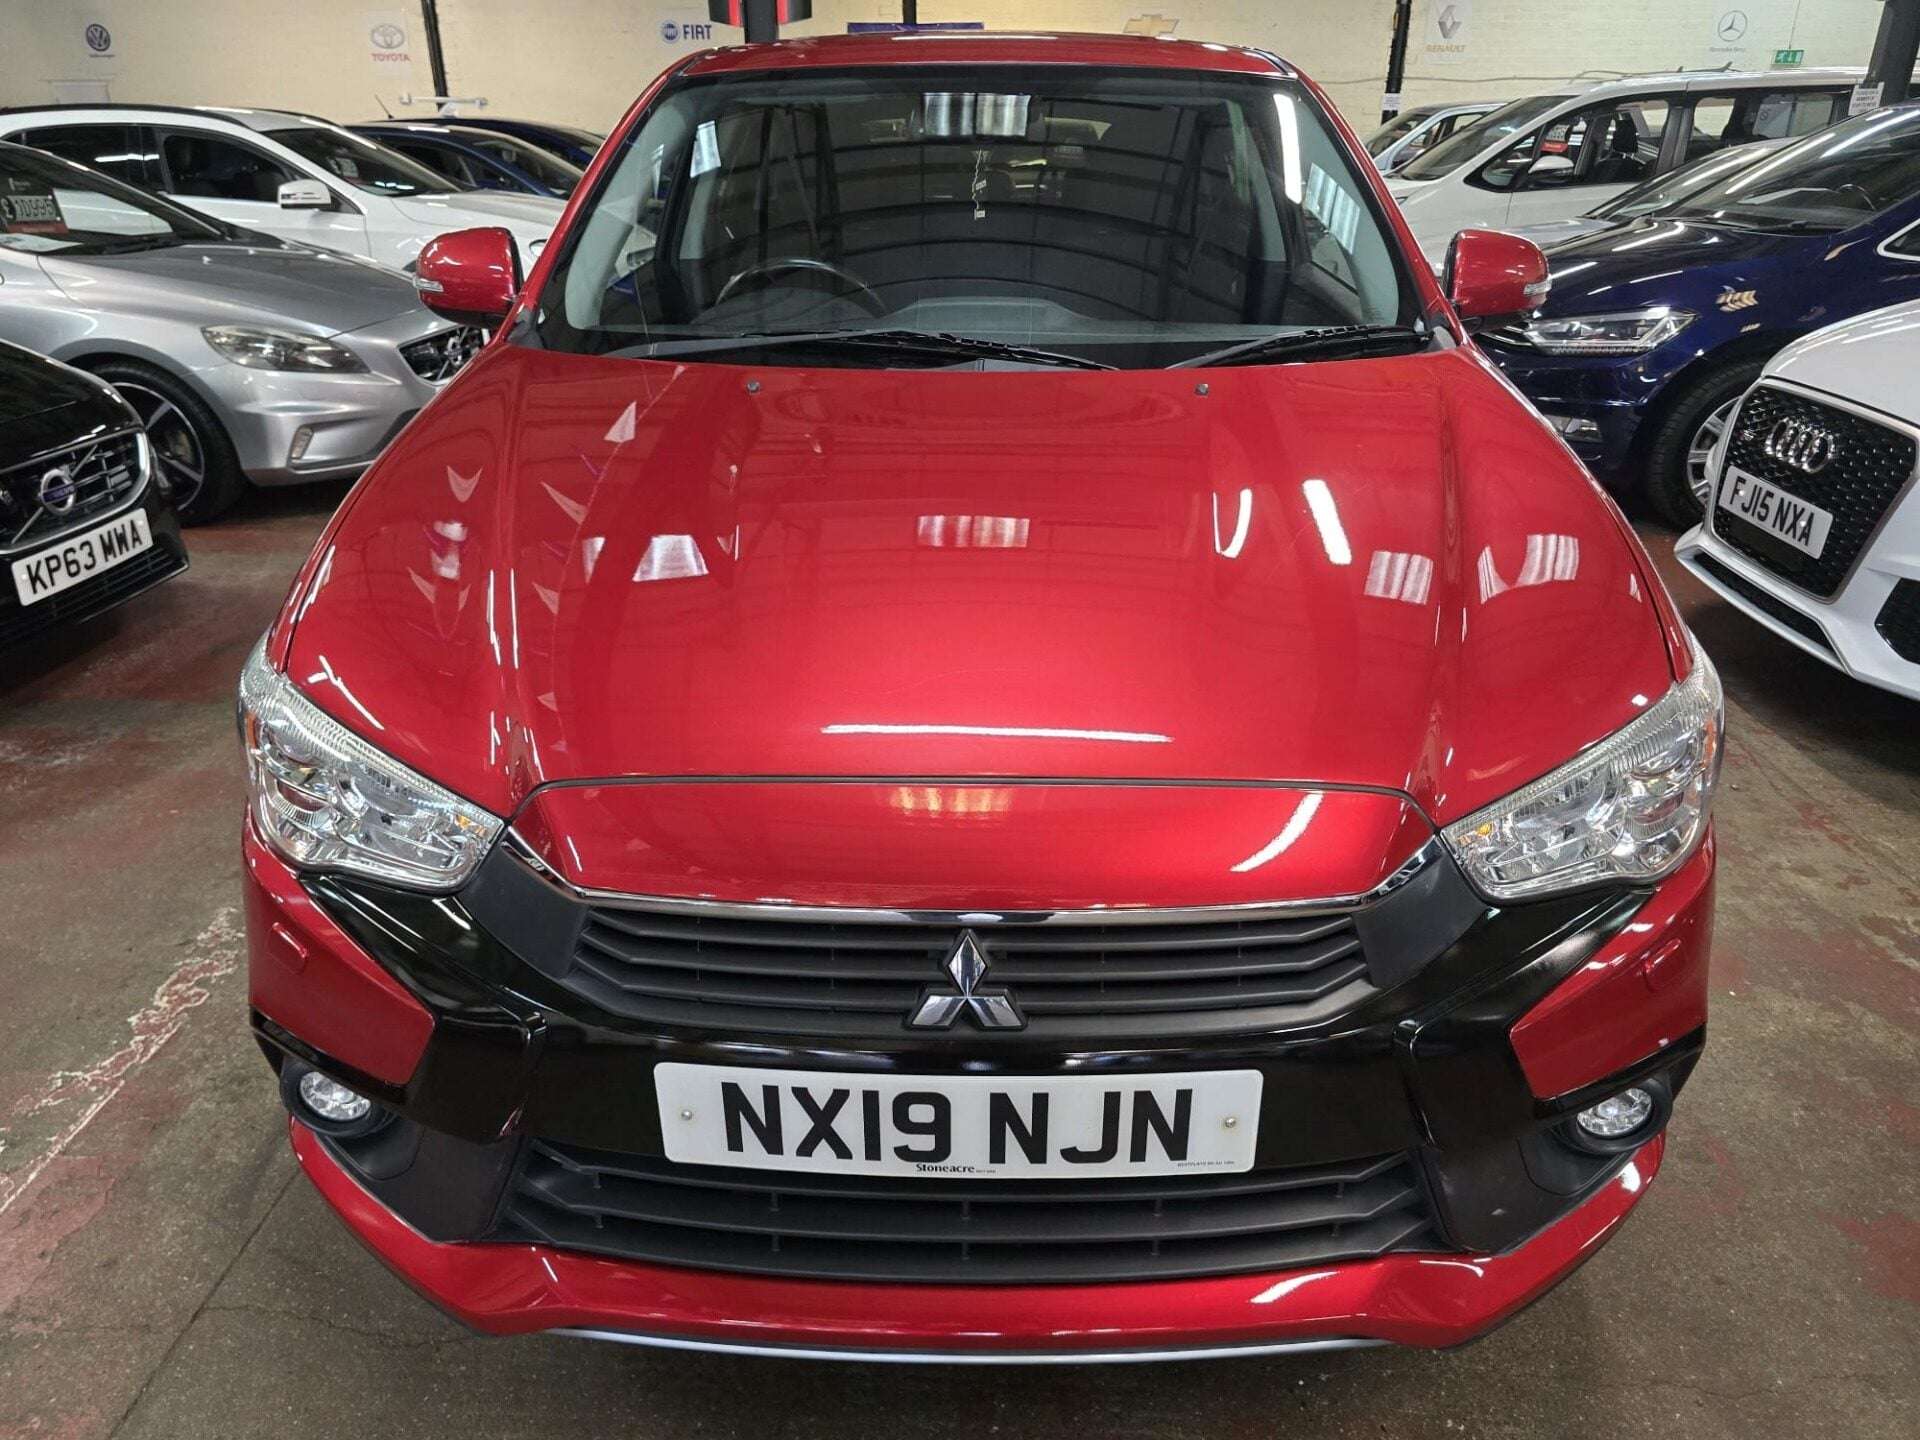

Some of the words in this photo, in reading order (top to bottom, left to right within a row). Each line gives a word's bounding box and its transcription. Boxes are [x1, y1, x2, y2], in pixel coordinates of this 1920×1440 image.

[683, 25, 712, 40] FIAT
[371, 53, 411, 62] TOYOTA
[1729, 475, 1775, 521] FJ15
[1772, 497, 1815, 547] NXA
[26, 540, 97, 595] KP63
[99, 519, 143, 562] MWA
[720, 1081, 952, 1164] NX19
[988, 1087, 1193, 1165] NJN
[915, 1162, 975, 1174] Stoneacre
